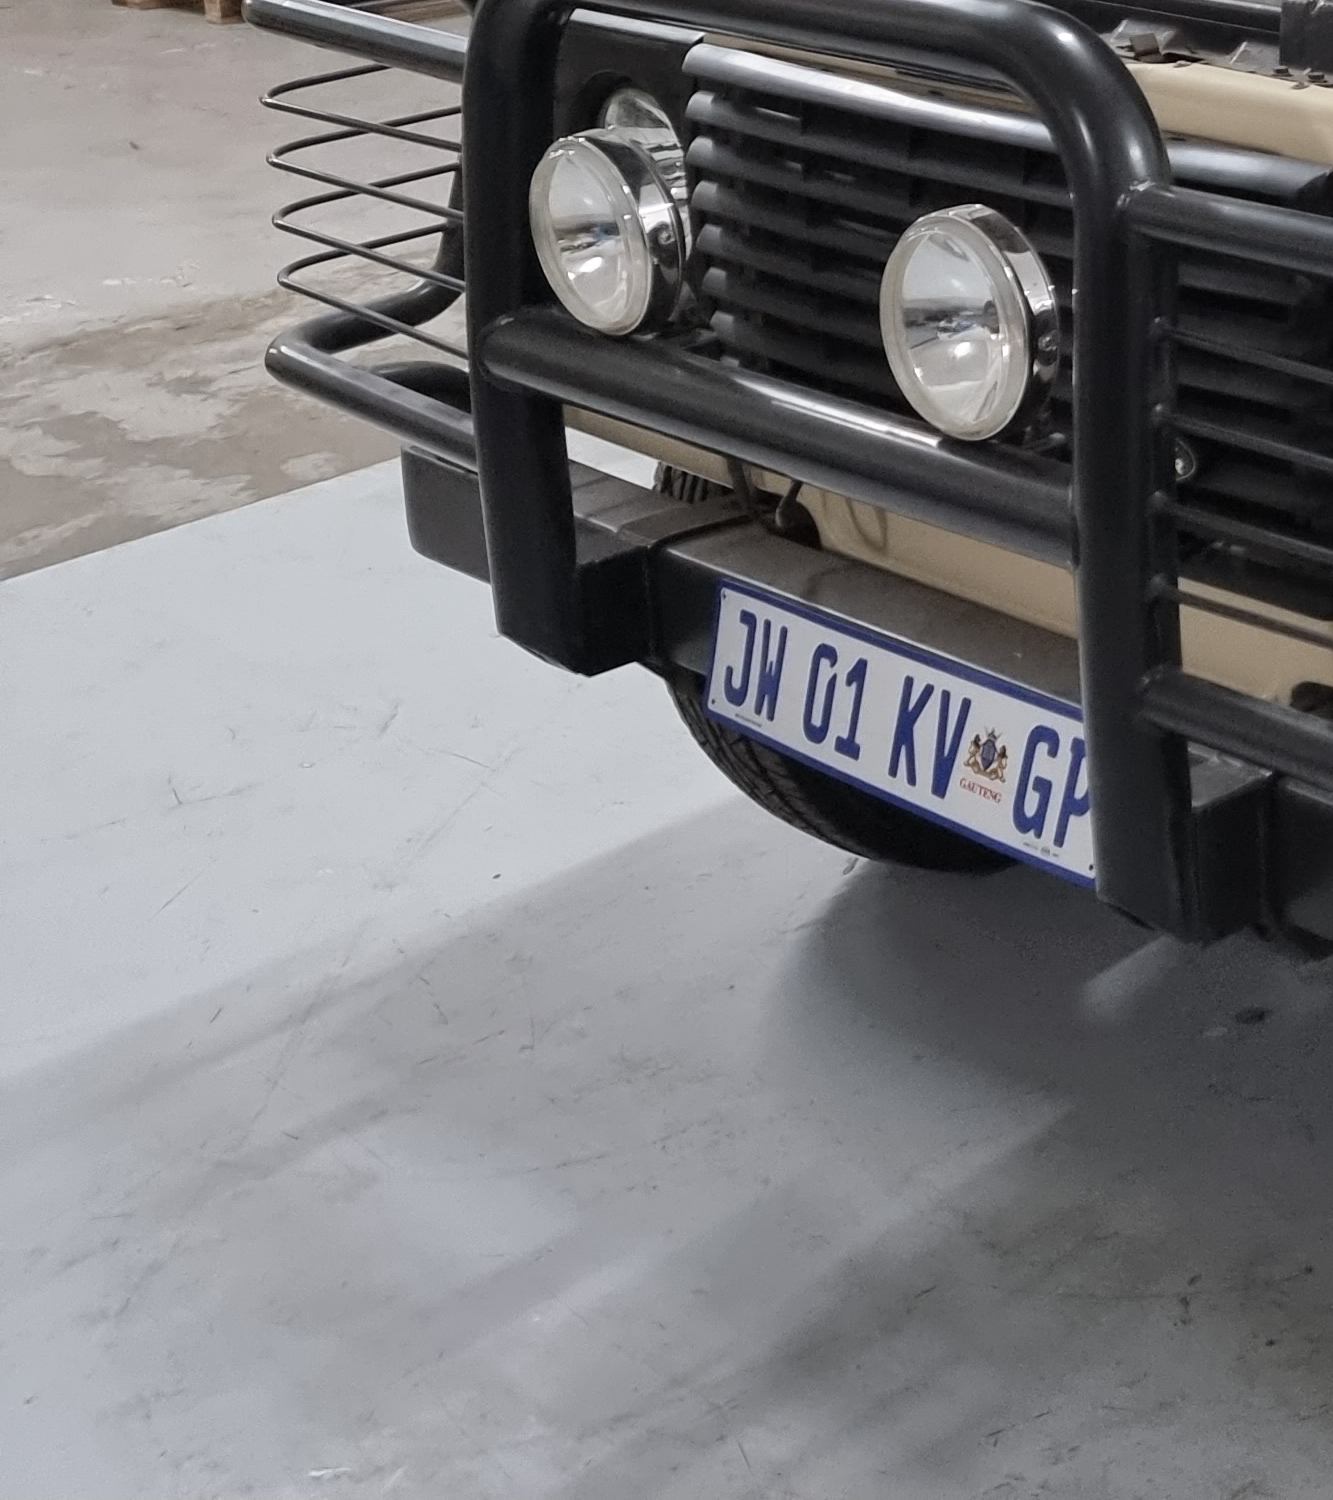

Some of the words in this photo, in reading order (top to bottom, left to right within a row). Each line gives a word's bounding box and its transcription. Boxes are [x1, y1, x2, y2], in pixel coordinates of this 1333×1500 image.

[724, 610, 788, 721] JW
[803, 642, 868, 760] 01
[888, 675, 971, 799] KV
[958, 777, 1003, 804] GAUTENG
